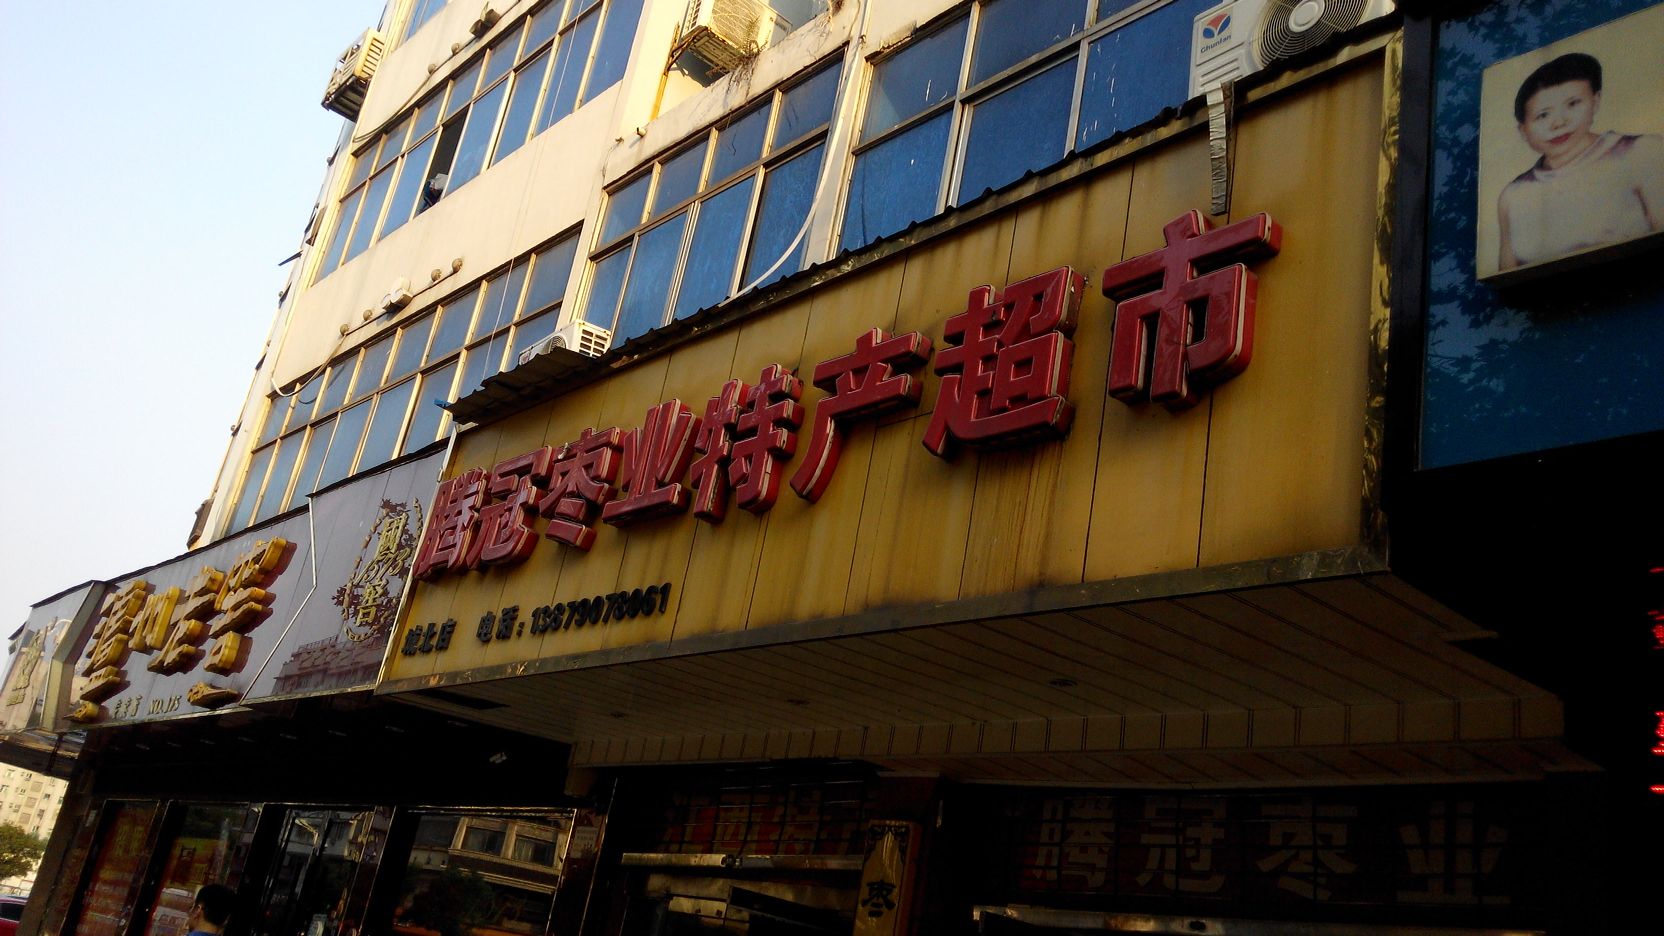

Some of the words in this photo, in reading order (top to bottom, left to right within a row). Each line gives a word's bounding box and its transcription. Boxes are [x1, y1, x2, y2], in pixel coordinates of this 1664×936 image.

[412, 209, 1283, 578] 腾冠枣业特产超市
[1033, 793, 1512, 906] 腾冠枣业
